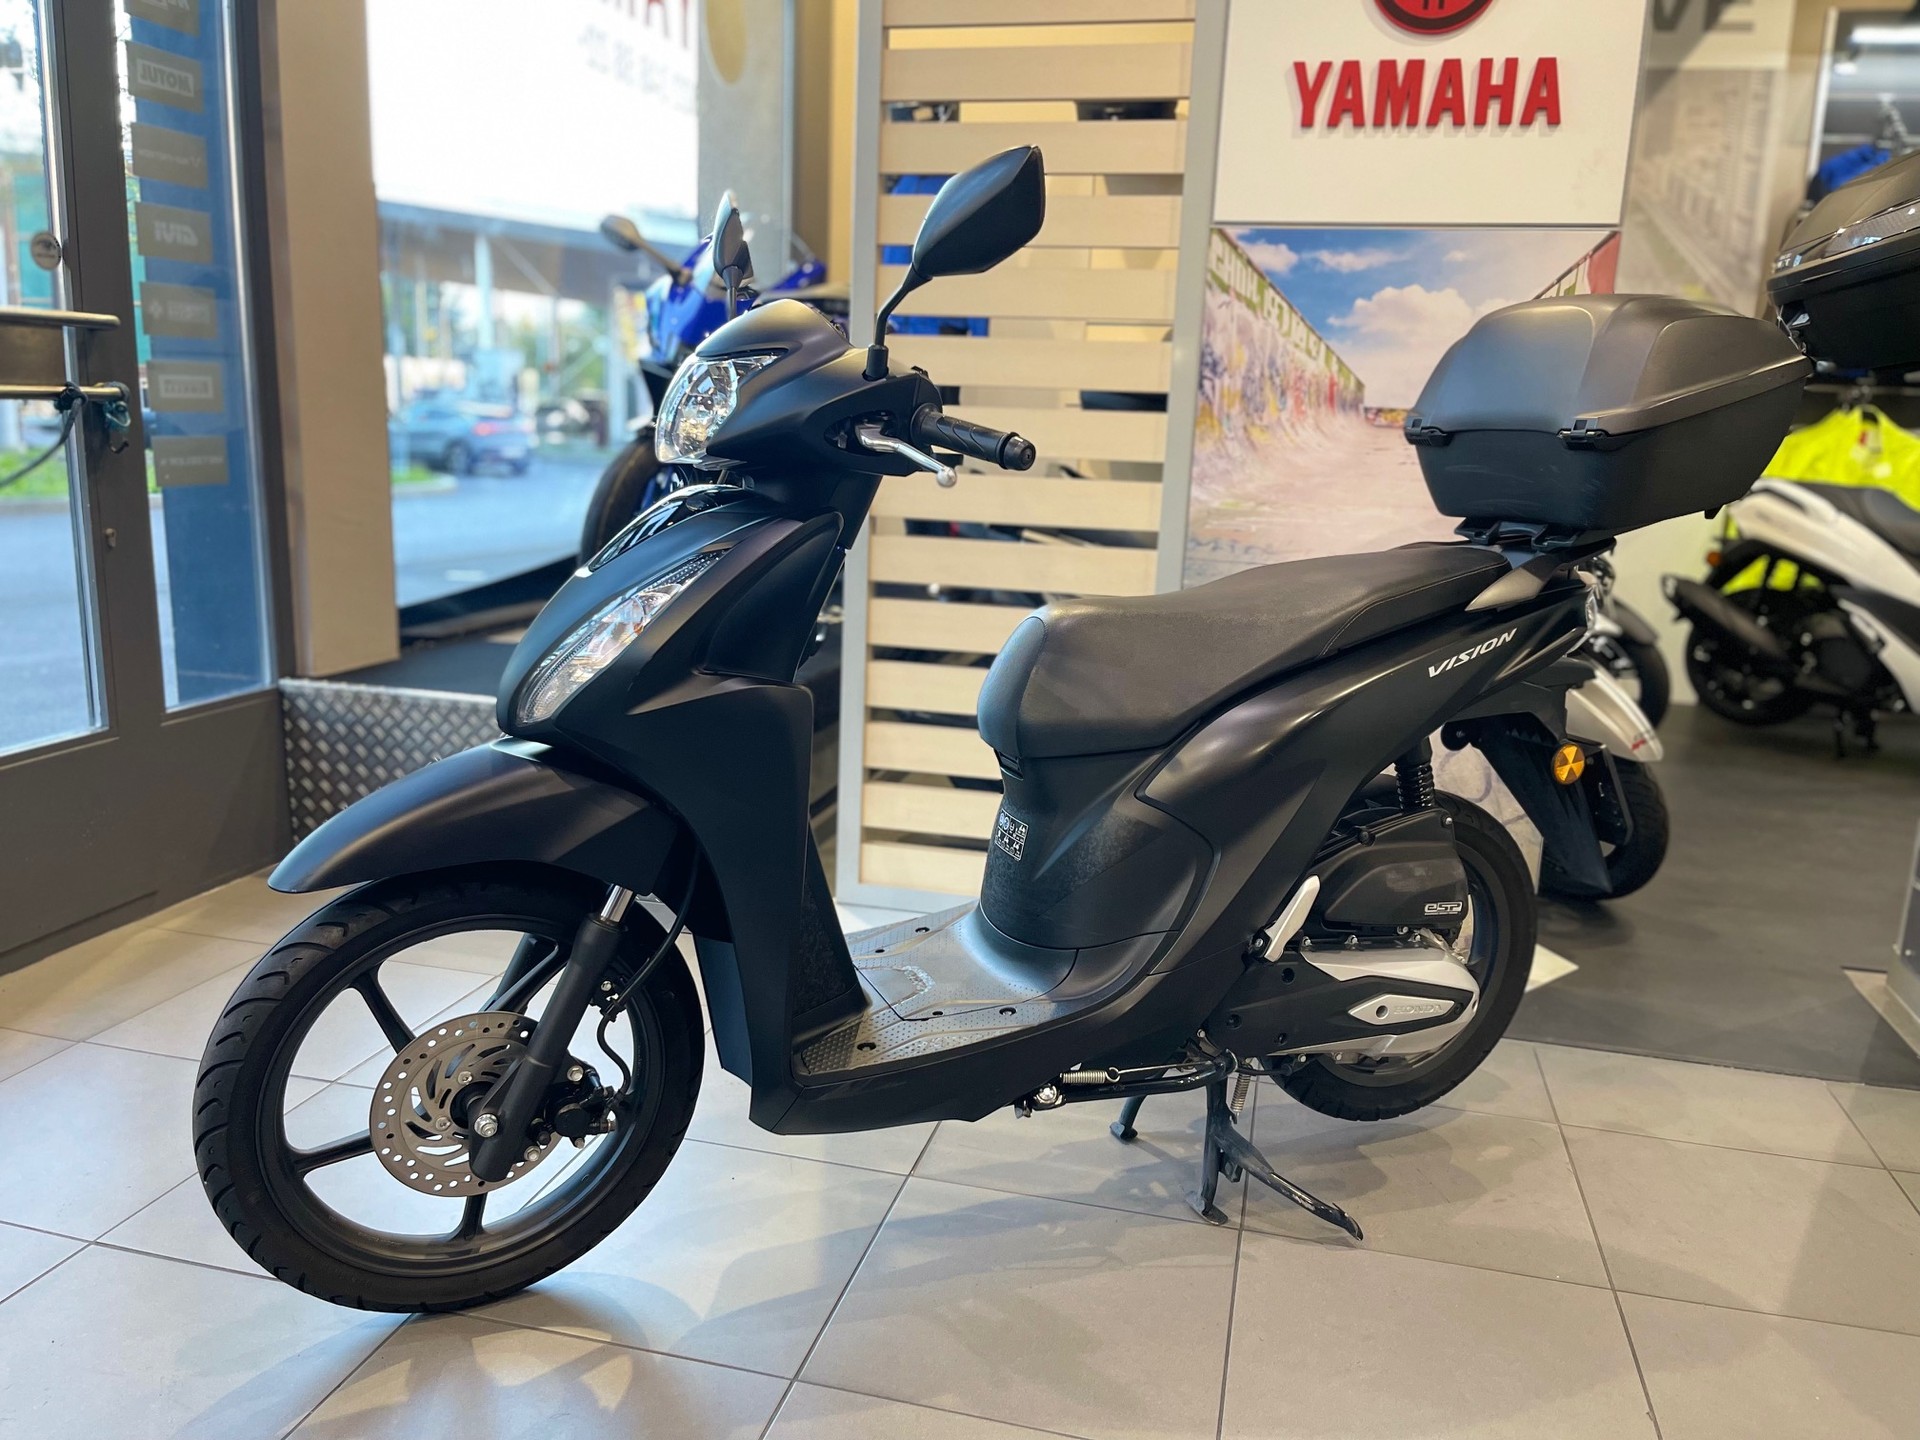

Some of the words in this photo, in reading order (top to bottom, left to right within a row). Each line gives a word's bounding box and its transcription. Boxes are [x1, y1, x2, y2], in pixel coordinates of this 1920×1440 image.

[1293, 57, 1561, 128] YAMAHA
[1428, 628, 1517, 678] VISION
[1394, 1003, 1442, 1015] HONDA
